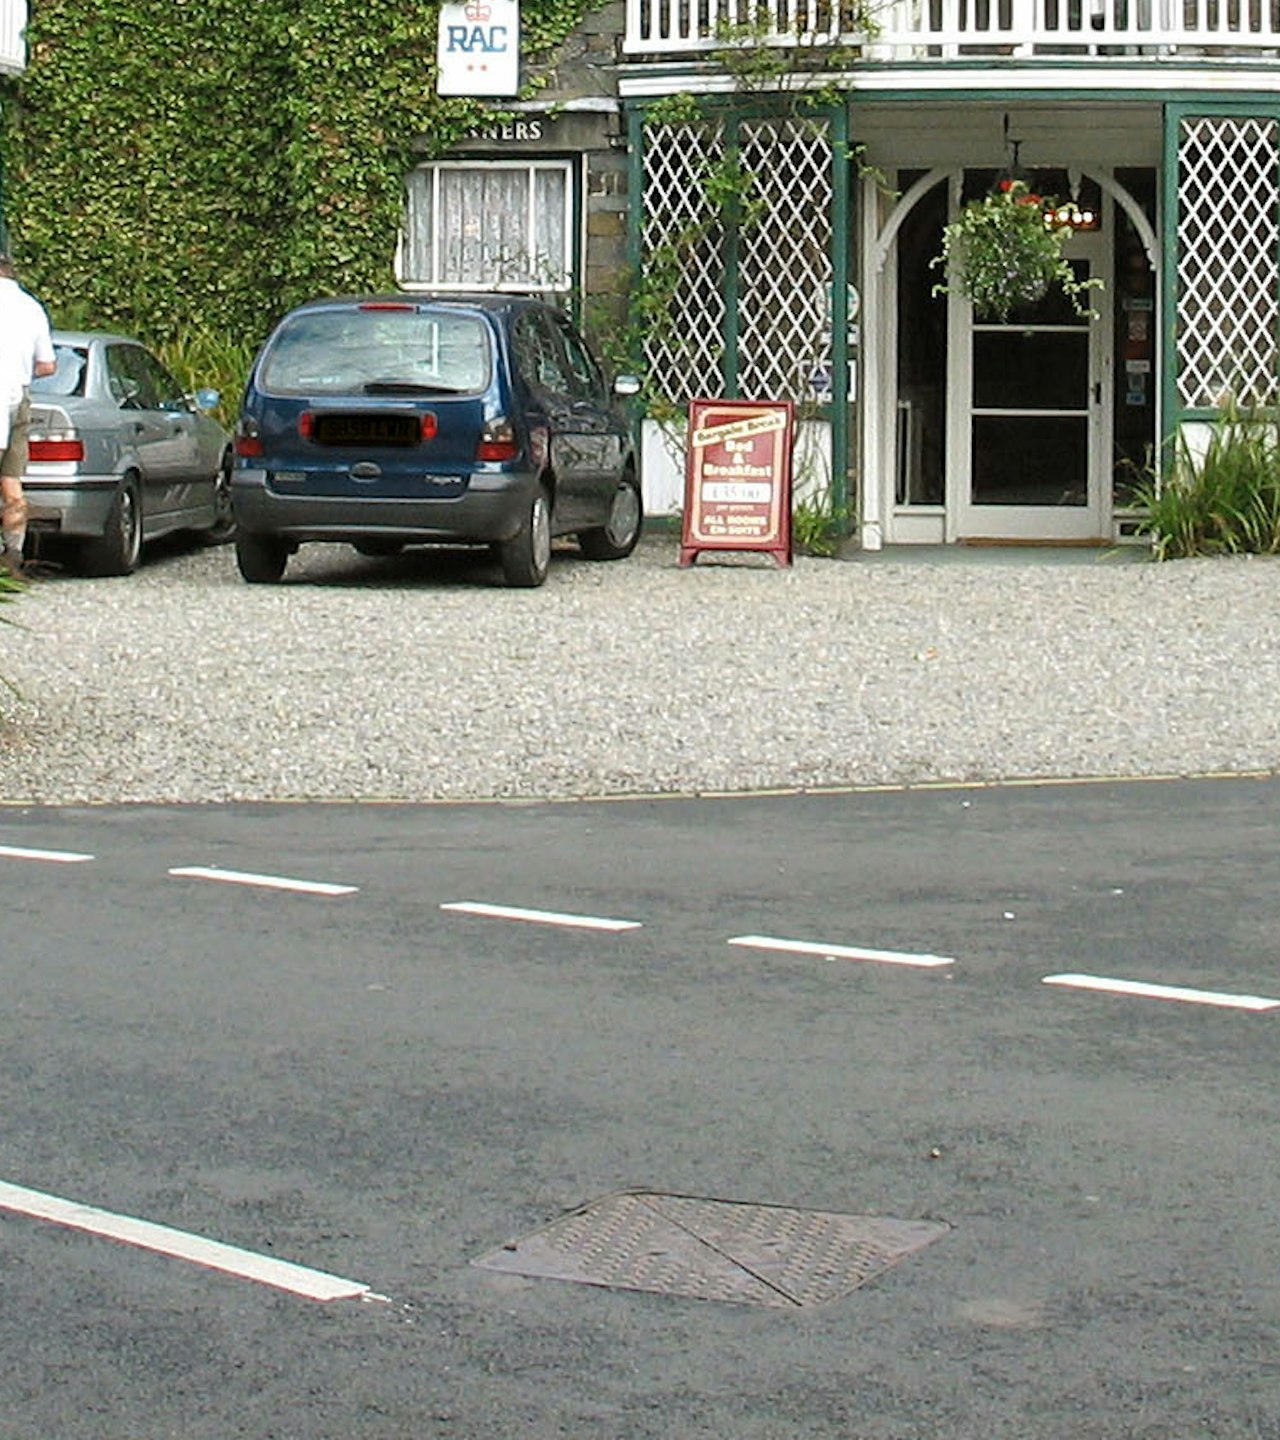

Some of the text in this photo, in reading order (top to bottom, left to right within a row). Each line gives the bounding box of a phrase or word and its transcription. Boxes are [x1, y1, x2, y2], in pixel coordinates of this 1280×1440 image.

[446, 25, 507, 53] RAC
[725, 440, 754, 452] Bed
[703, 464, 772, 477] Breakfast
